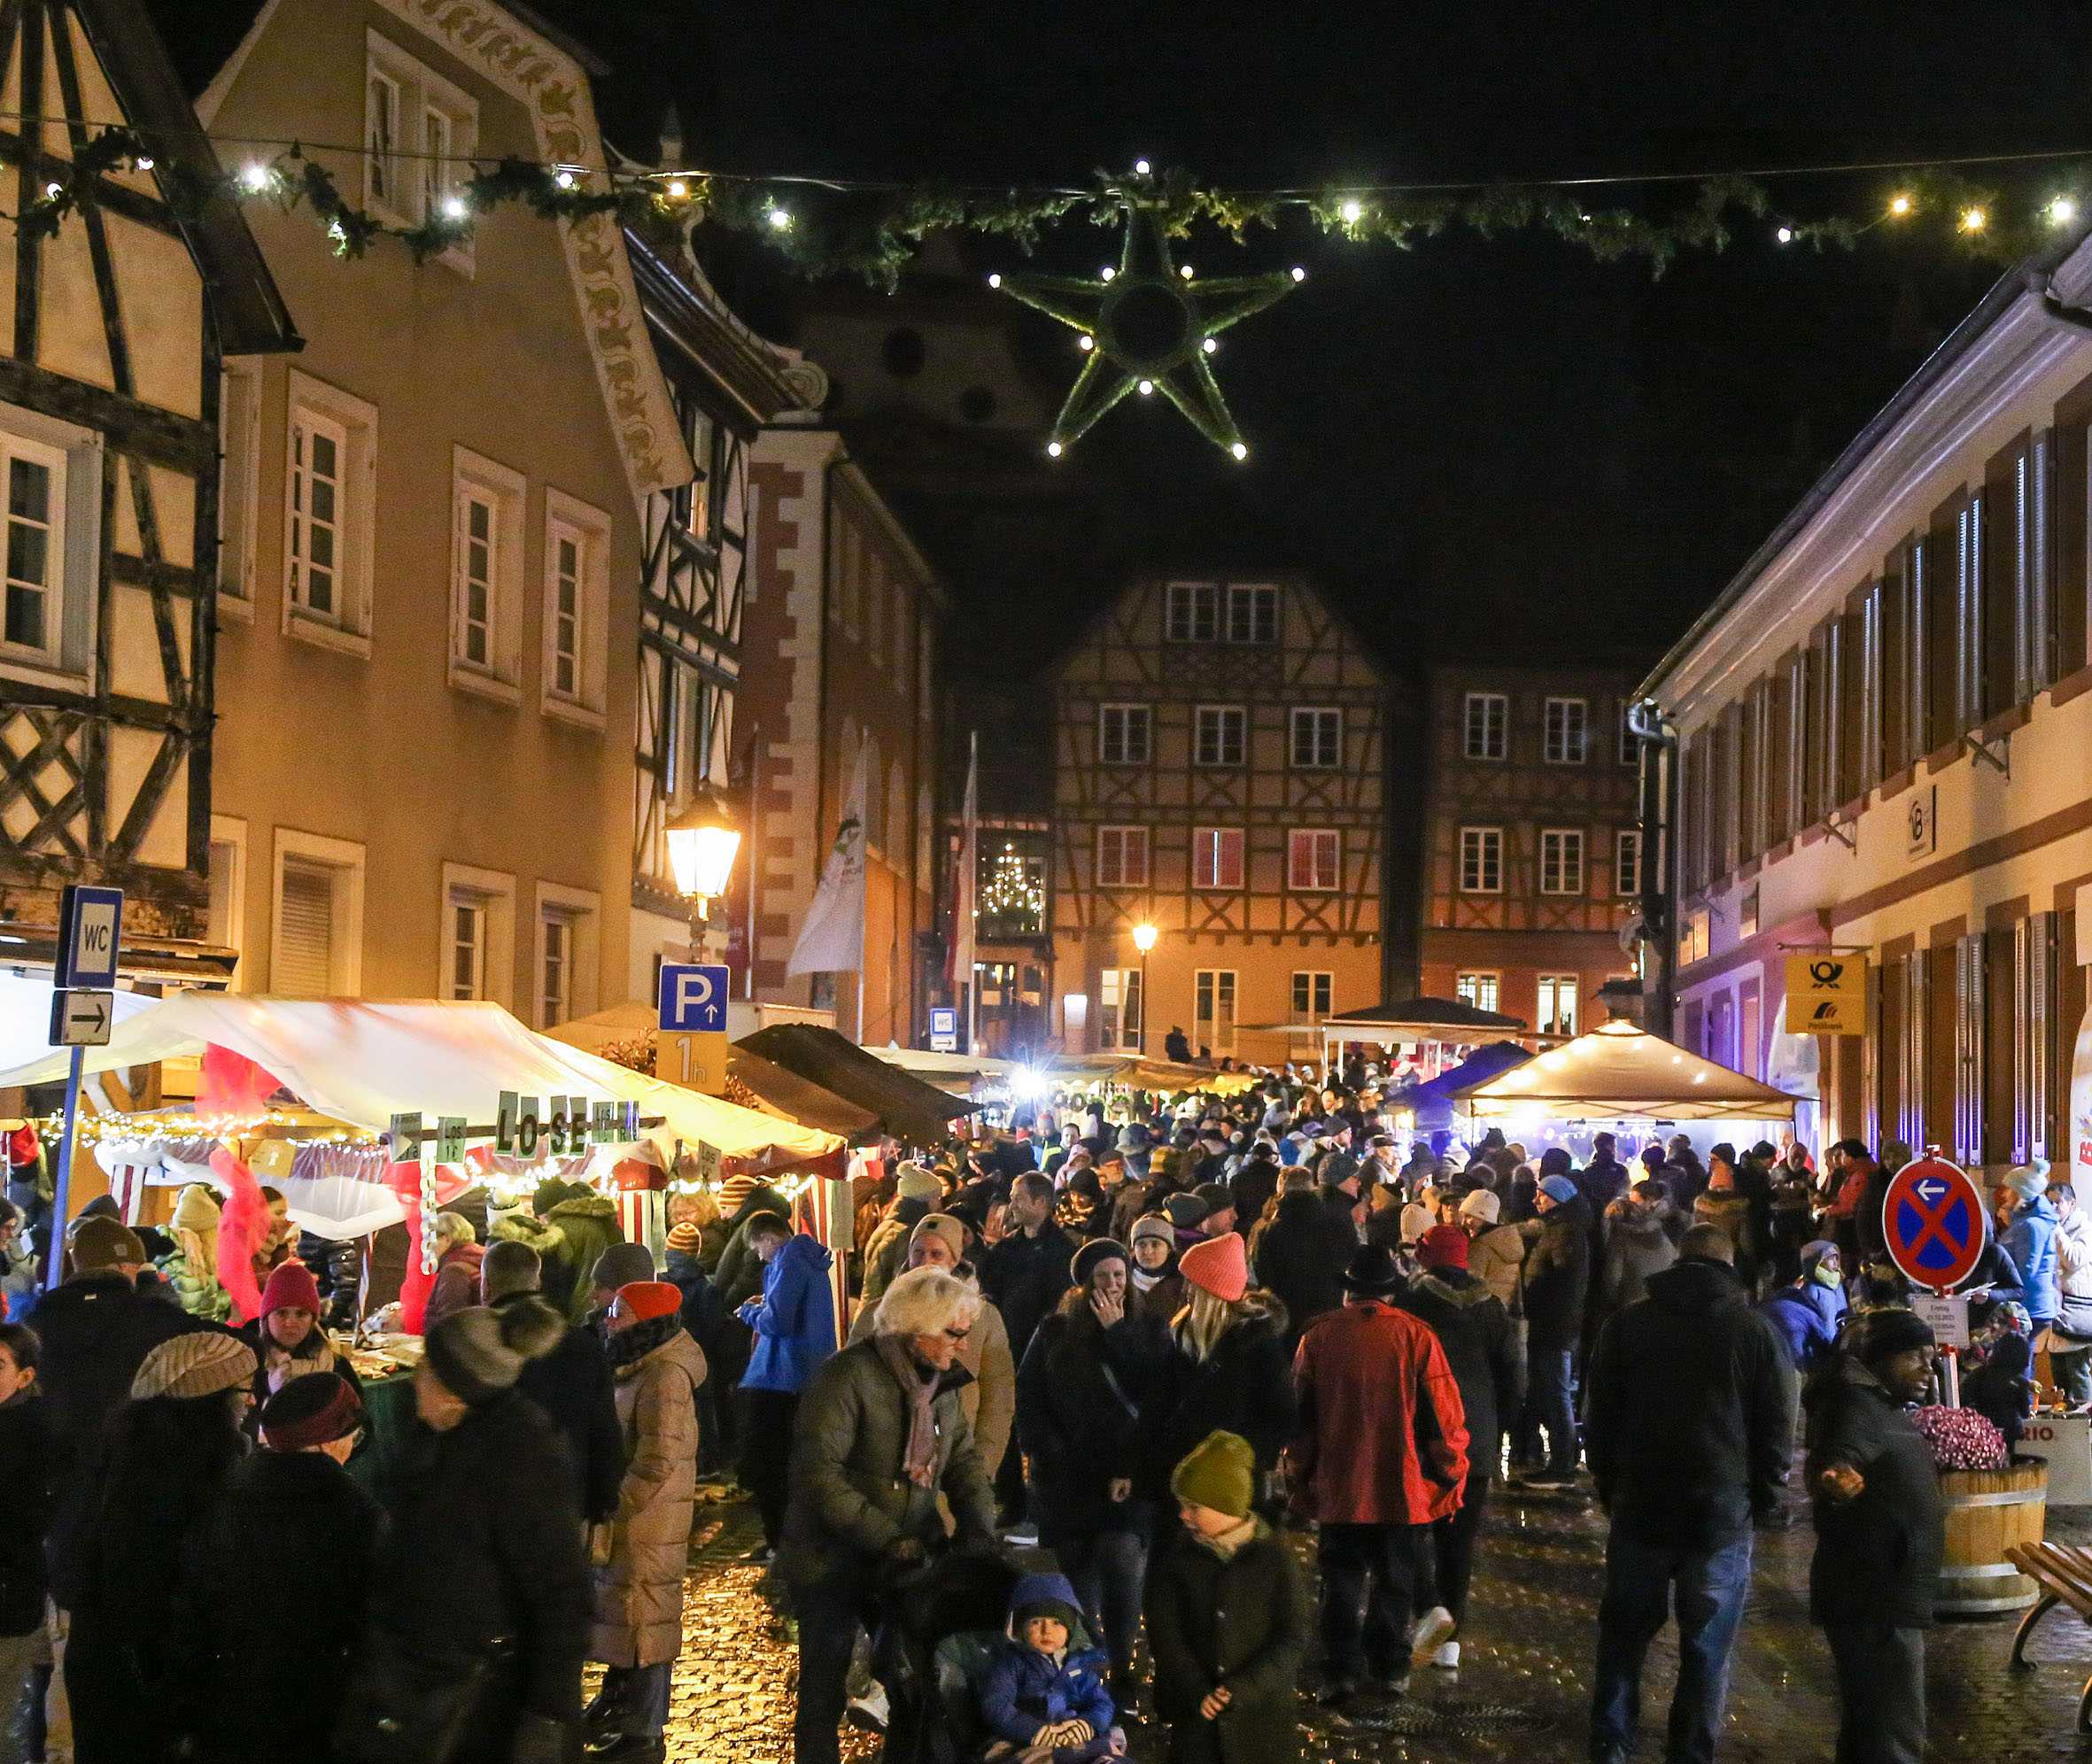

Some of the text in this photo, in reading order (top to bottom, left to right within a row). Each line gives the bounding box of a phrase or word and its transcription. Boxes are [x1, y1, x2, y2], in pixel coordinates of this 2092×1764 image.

[84, 924, 108, 952] WC
[675, 973, 712, 1023] P
[496, 1109, 586, 1156] LOSE
